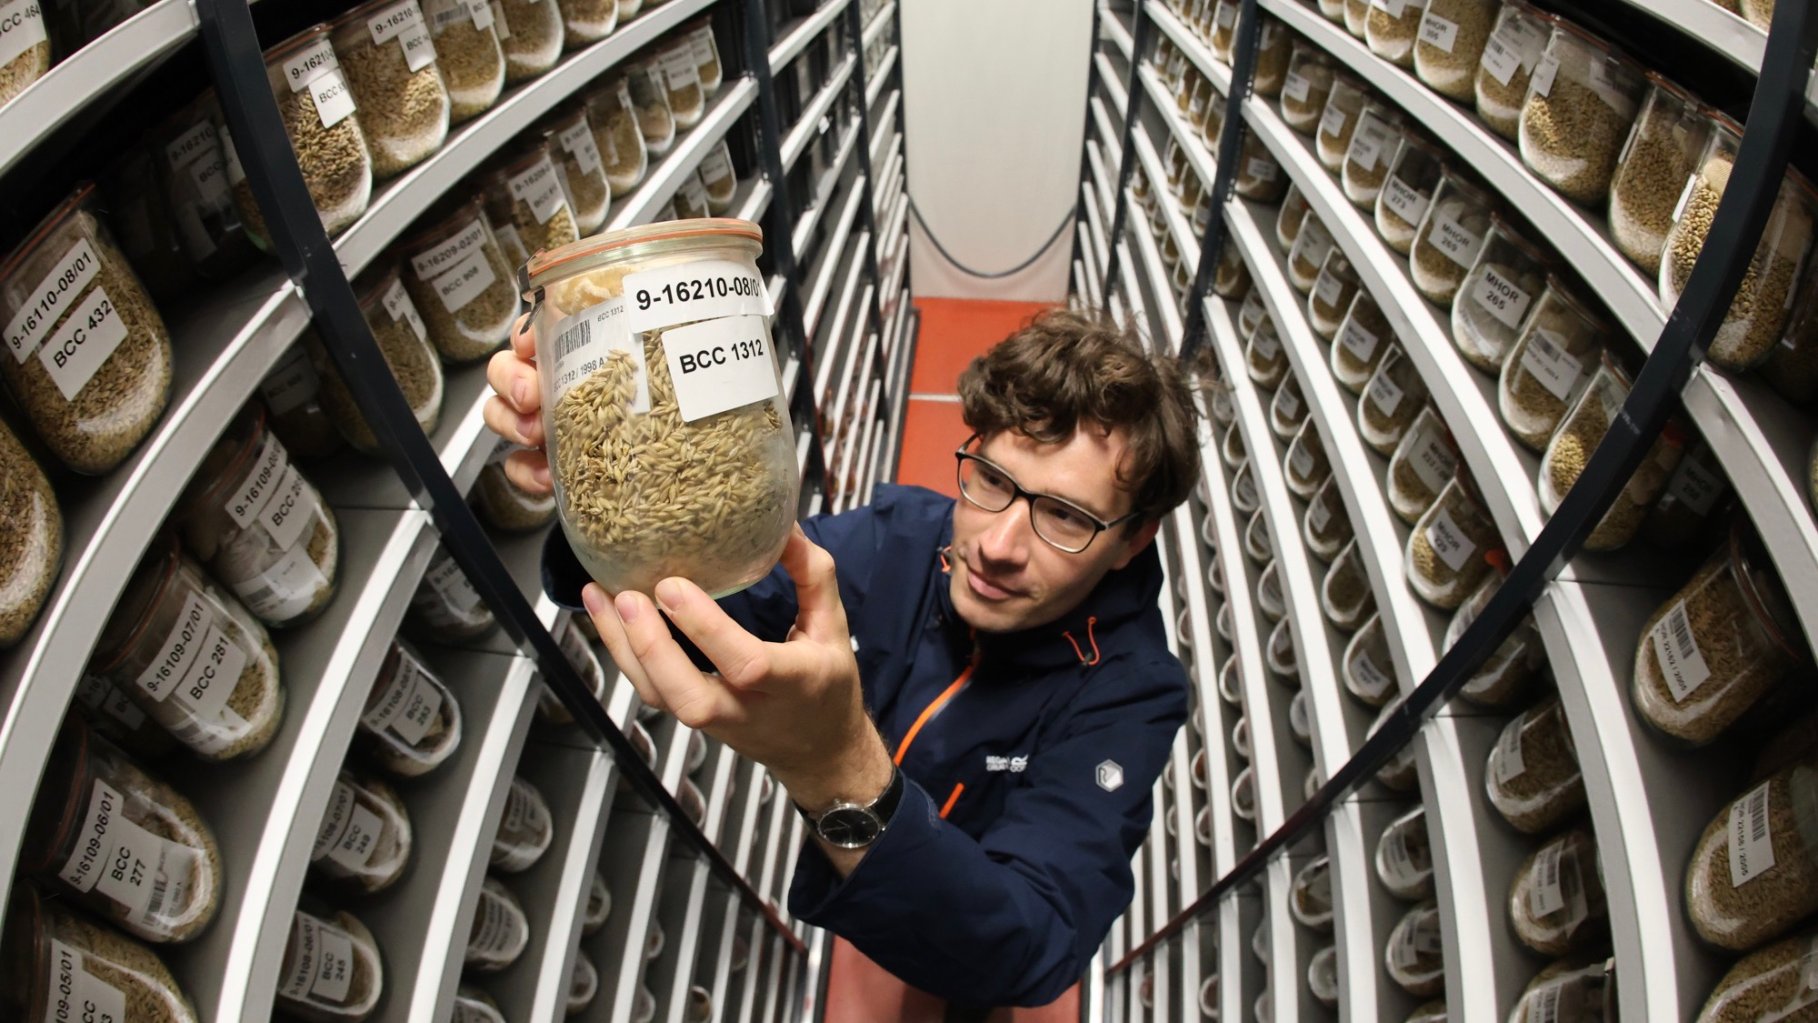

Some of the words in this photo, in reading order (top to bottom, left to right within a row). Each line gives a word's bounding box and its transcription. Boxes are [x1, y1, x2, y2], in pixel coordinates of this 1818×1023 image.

[0, 12, 22, 37] CC
[319, 86, 339, 104] BCC
[1441, 236, 1458, 252] 269
[1442, 223, 1470, 247] MHOR
[11, 251, 92, 350] 9-16110-08/01
[441, 277, 463, 295] BCC
[635, 276, 762, 311] 9-16210-08/01
[1485, 272, 1519, 303] MHOR
[1486, 291, 1506, 310] 265
[610, 305, 624, 316] 1312
[53, 328, 87, 368] BCC
[88, 300, 113, 330] 432
[562, 370, 575, 385] 1312
[580, 360, 598, 375] 1998
[598, 357, 605, 368] A
[679, 346, 727, 375] BCC
[730, 338, 764, 361] 1312
[271, 494, 295, 527] BCC
[146, 602, 205, 692] 9-16109-07/01
[190, 665, 215, 700] BCC
[211, 636, 230, 665] 281
[406, 694, 423, 720] BCC
[69, 790, 115, 886] 9-16109-06/01
[343, 824, 361, 850] BCC
[110, 846, 131, 882] BCC
[129, 858, 147, 887] 277
[322, 951, 335, 981] BCC
